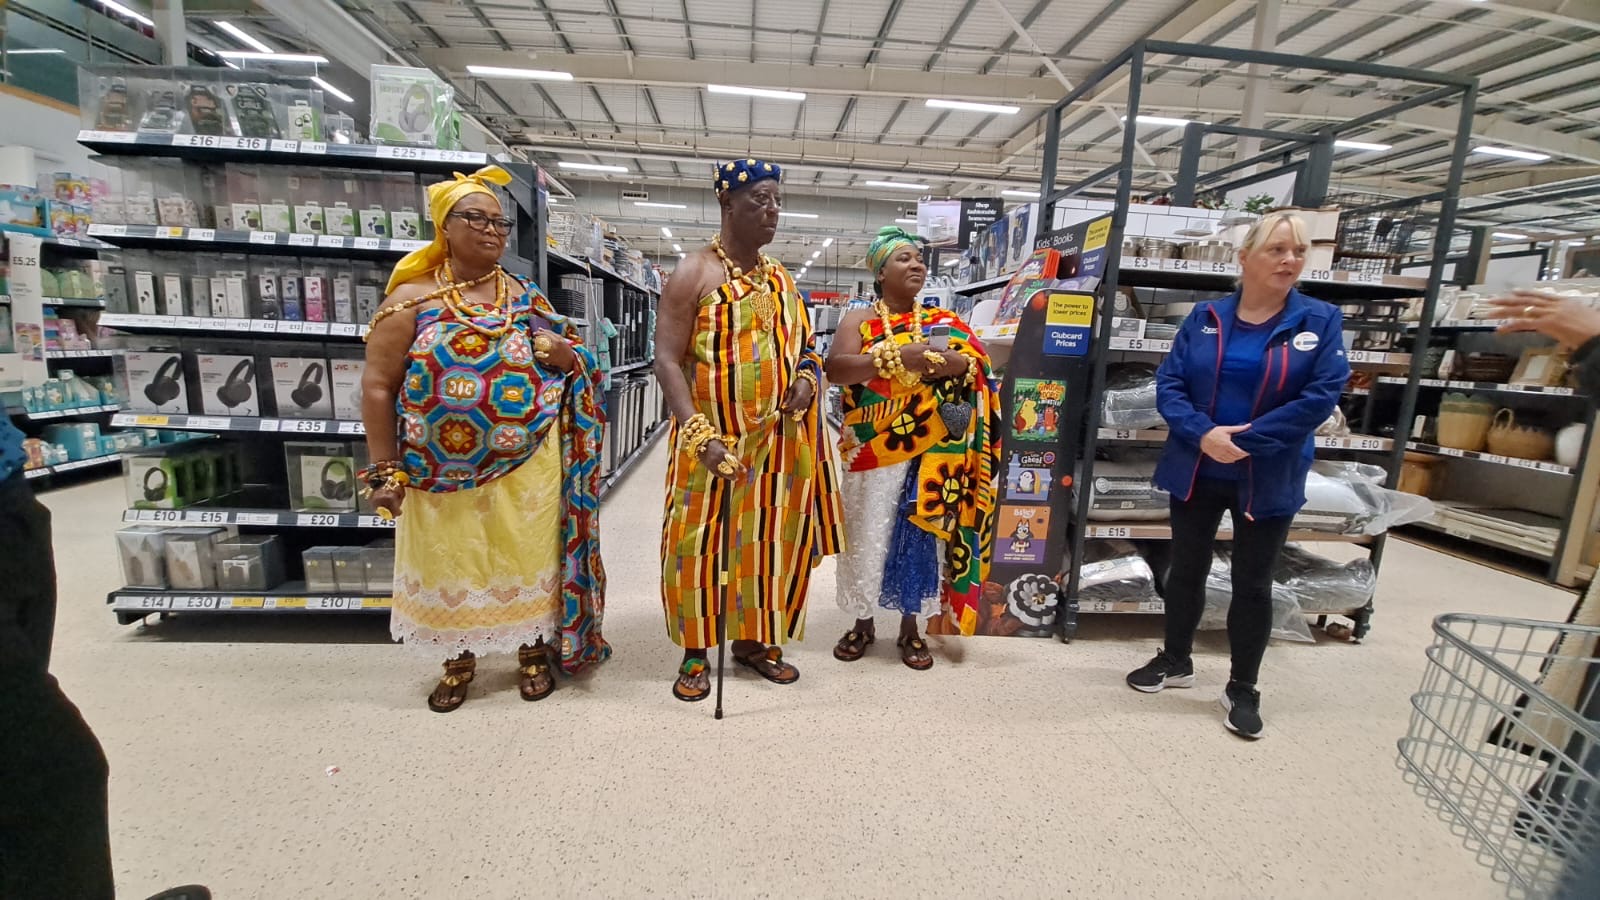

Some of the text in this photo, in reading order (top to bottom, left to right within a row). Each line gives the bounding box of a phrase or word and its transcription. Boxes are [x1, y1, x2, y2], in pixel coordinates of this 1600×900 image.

[190, 136, 213, 146] £16
[237, 138, 260, 149] £16
[392, 148, 417, 158] £25
[440, 150, 464, 160] £25
[1053, 232, 1074, 246] Books
[12, 256, 37, 266] £5.25
[1134, 257, 1149, 268] £3
[1174, 261, 1188, 270] £4
[1212, 262, 1225, 272] £5
[1311, 270, 1329, 280] £10
[1358, 272, 1372, 282] £15
[1051, 331, 1083, 340] Clubcard
[1129, 339, 1143, 349] £5
[297, 421, 321, 432] £35
[1116, 430, 1130, 439] £3
[1324, 438, 1337, 447] £6
[1361, 439, 1379, 449] £10
[153, 511, 176, 521] £10
[200, 513, 222, 522] £15
[311, 515, 335, 525] £20
[1108, 527, 1126, 537] £15
[142, 597, 164, 607] £14
[187, 597, 213, 608] £30
[321, 597, 344, 608] £10
[1093, 602, 1106, 611] £5
